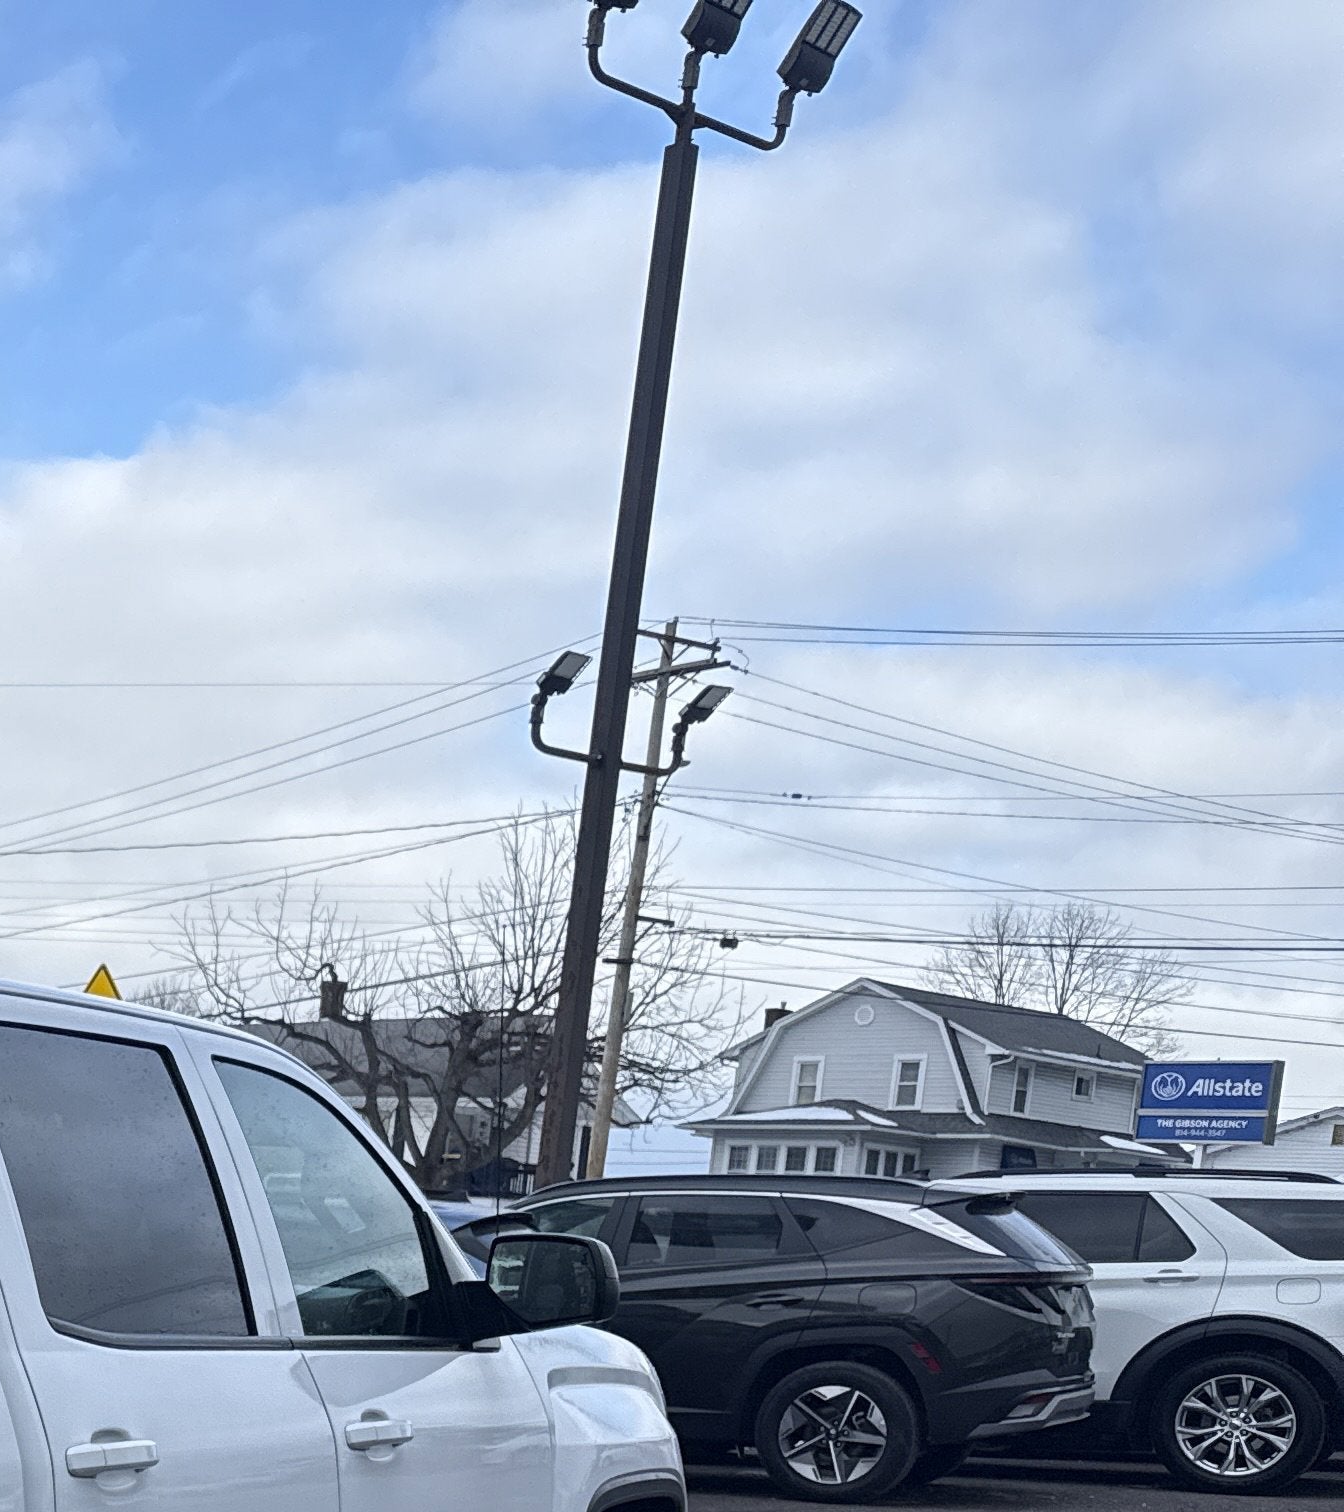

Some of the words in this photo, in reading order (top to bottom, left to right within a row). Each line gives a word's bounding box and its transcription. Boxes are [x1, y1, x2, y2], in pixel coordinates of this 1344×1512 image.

[1187, 1078, 1263, 1097] Allstate
[1156, 1119, 1174, 1128] THE
[1175, 1119, 1209, 1129] GIBSON
[1210, 1120, 1249, 1129] AGENCY
